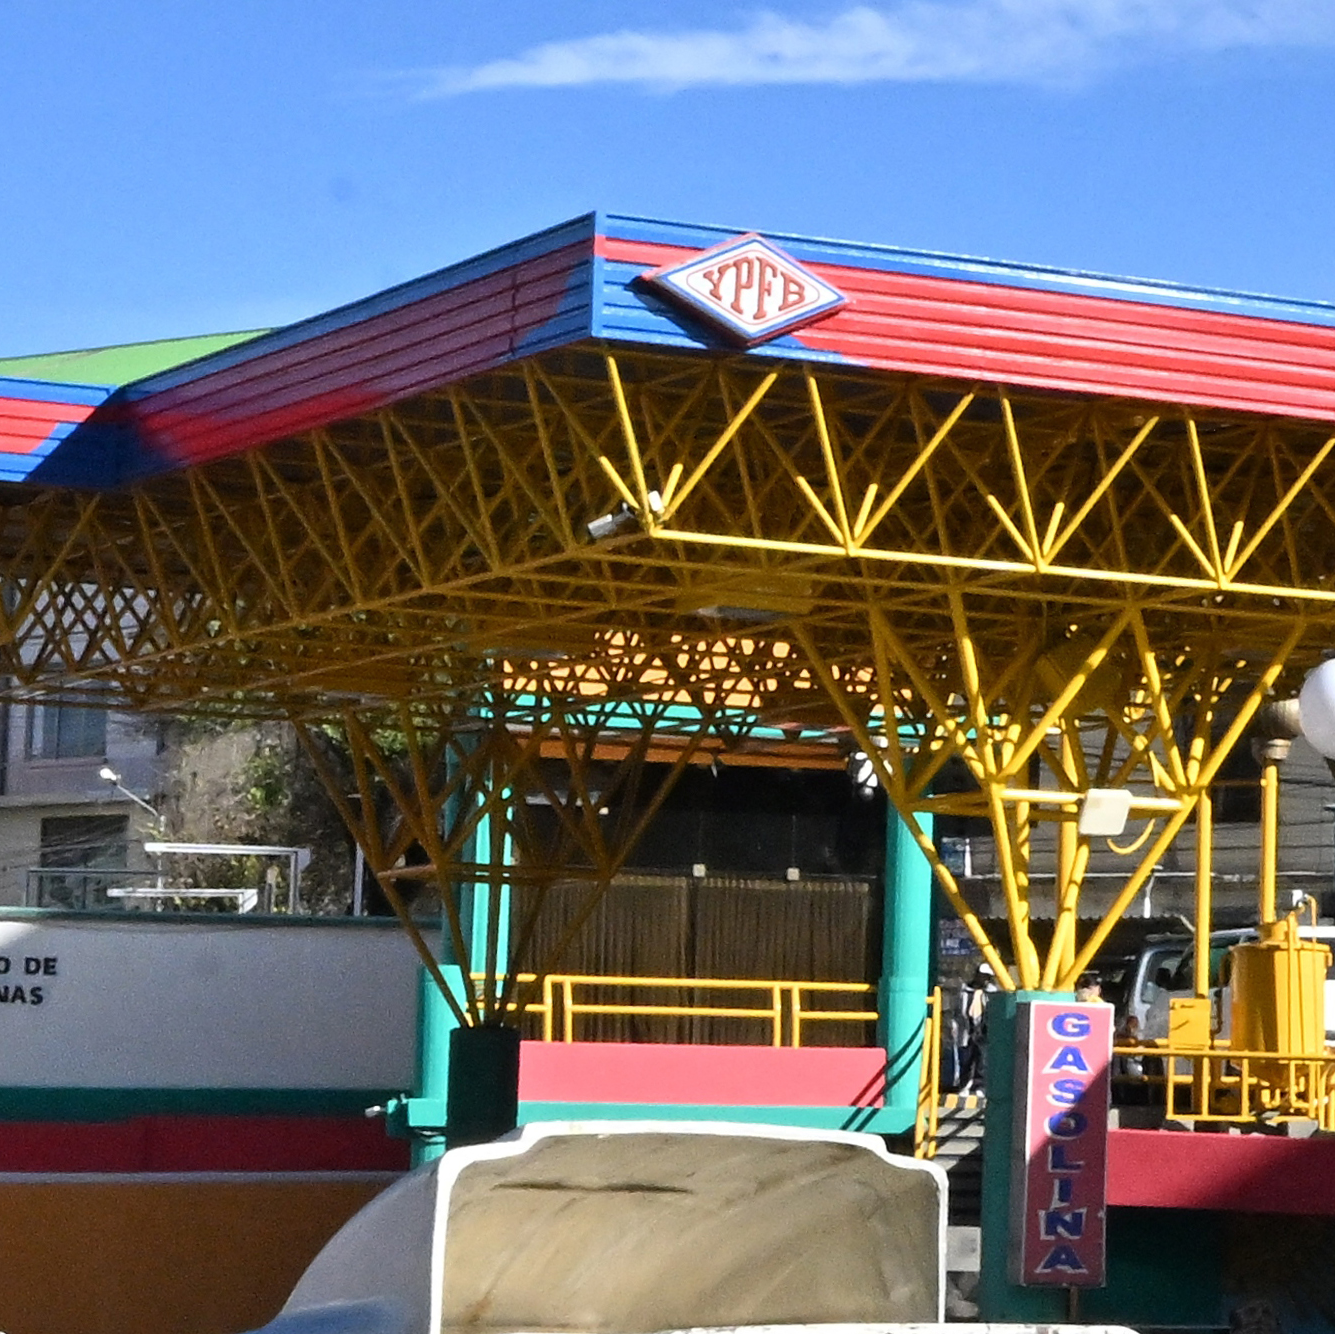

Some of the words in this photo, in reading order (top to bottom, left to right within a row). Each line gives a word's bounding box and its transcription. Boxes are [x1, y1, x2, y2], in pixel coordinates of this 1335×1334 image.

[703, 256, 806, 320] YPFB
[23, 956, 58, 976] DE
[1033, 1011, 1096, 1275] GASOLINA
